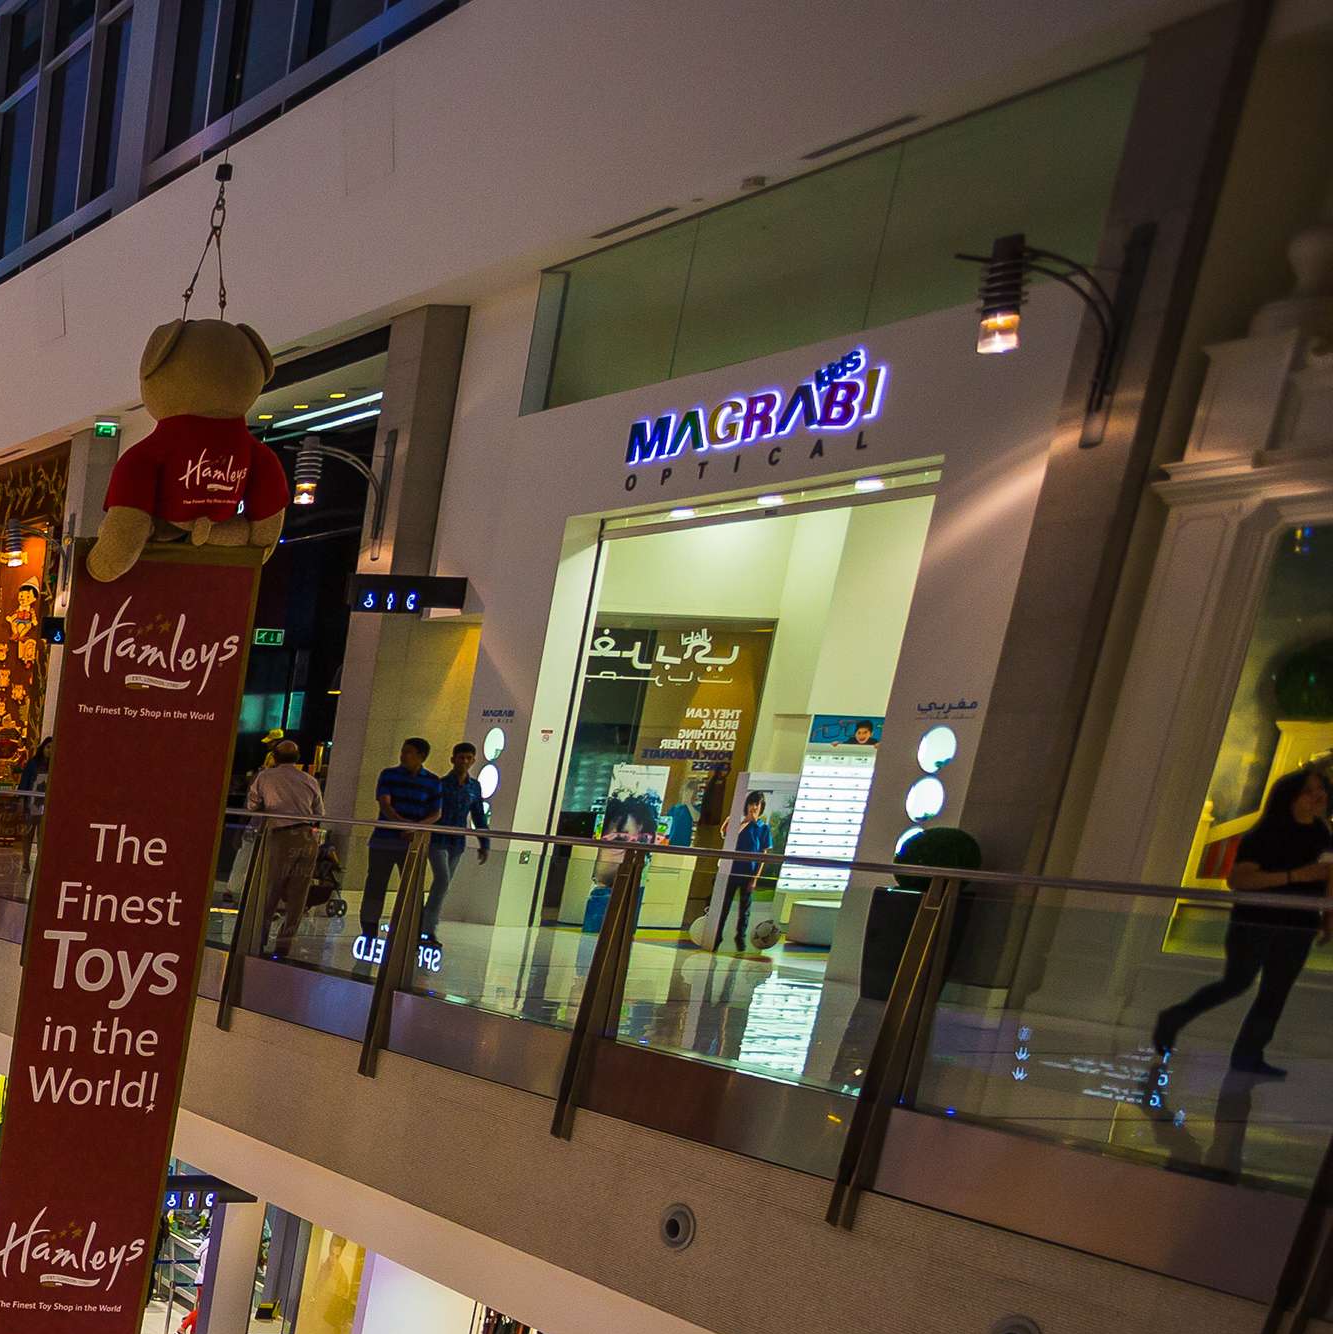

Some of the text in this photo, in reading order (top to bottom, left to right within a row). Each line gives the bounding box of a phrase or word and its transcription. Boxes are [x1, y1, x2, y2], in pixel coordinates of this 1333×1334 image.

[625, 366, 885, 465] MAGRABI
[179, 448, 247, 494] Hamleys
[624, 433, 868, 493] OPTICAL
[72, 596, 239, 696] Hamleys
[78, 705, 214, 720] The Finest Toy Shop in the World
[89, 823, 167, 866] The
[56, 880, 182, 927] Finest
[43, 929, 181, 1010] Toys
[42, 1016, 159, 1058] in the
[29, 1065, 159, 1113] World!
[12, 1301, 36, 1310] Finest
[39, 1302, 52, 1311] Toy
[53, 1302, 74, 1312] Shop
[84, 1304, 97, 1312] the
[99, 1304, 122, 1313] World
